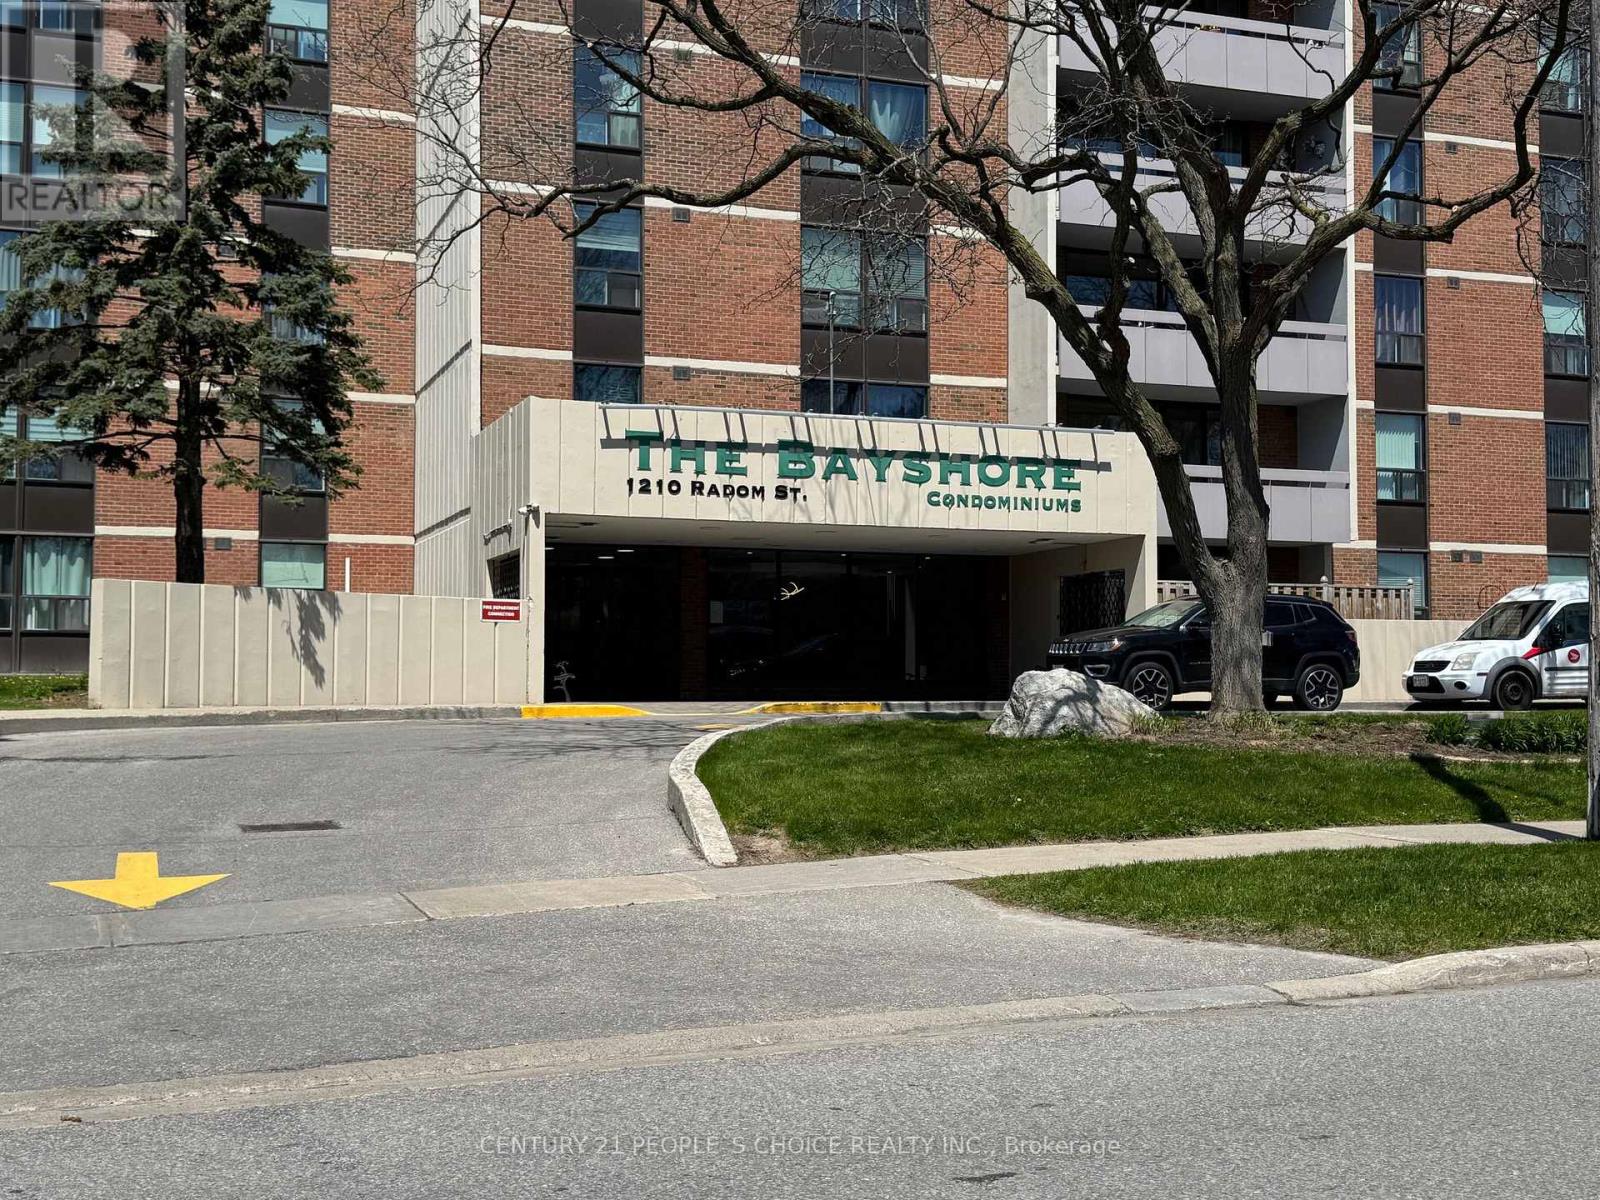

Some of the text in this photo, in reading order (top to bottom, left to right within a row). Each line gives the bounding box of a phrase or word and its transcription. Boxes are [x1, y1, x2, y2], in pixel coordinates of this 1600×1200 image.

[625, 428, 1082, 491] THE BAYSHORE
[627, 477, 808, 502] 1210 RADOM ST.
[926, 490, 1082, 513] CONDOMINIUMS
